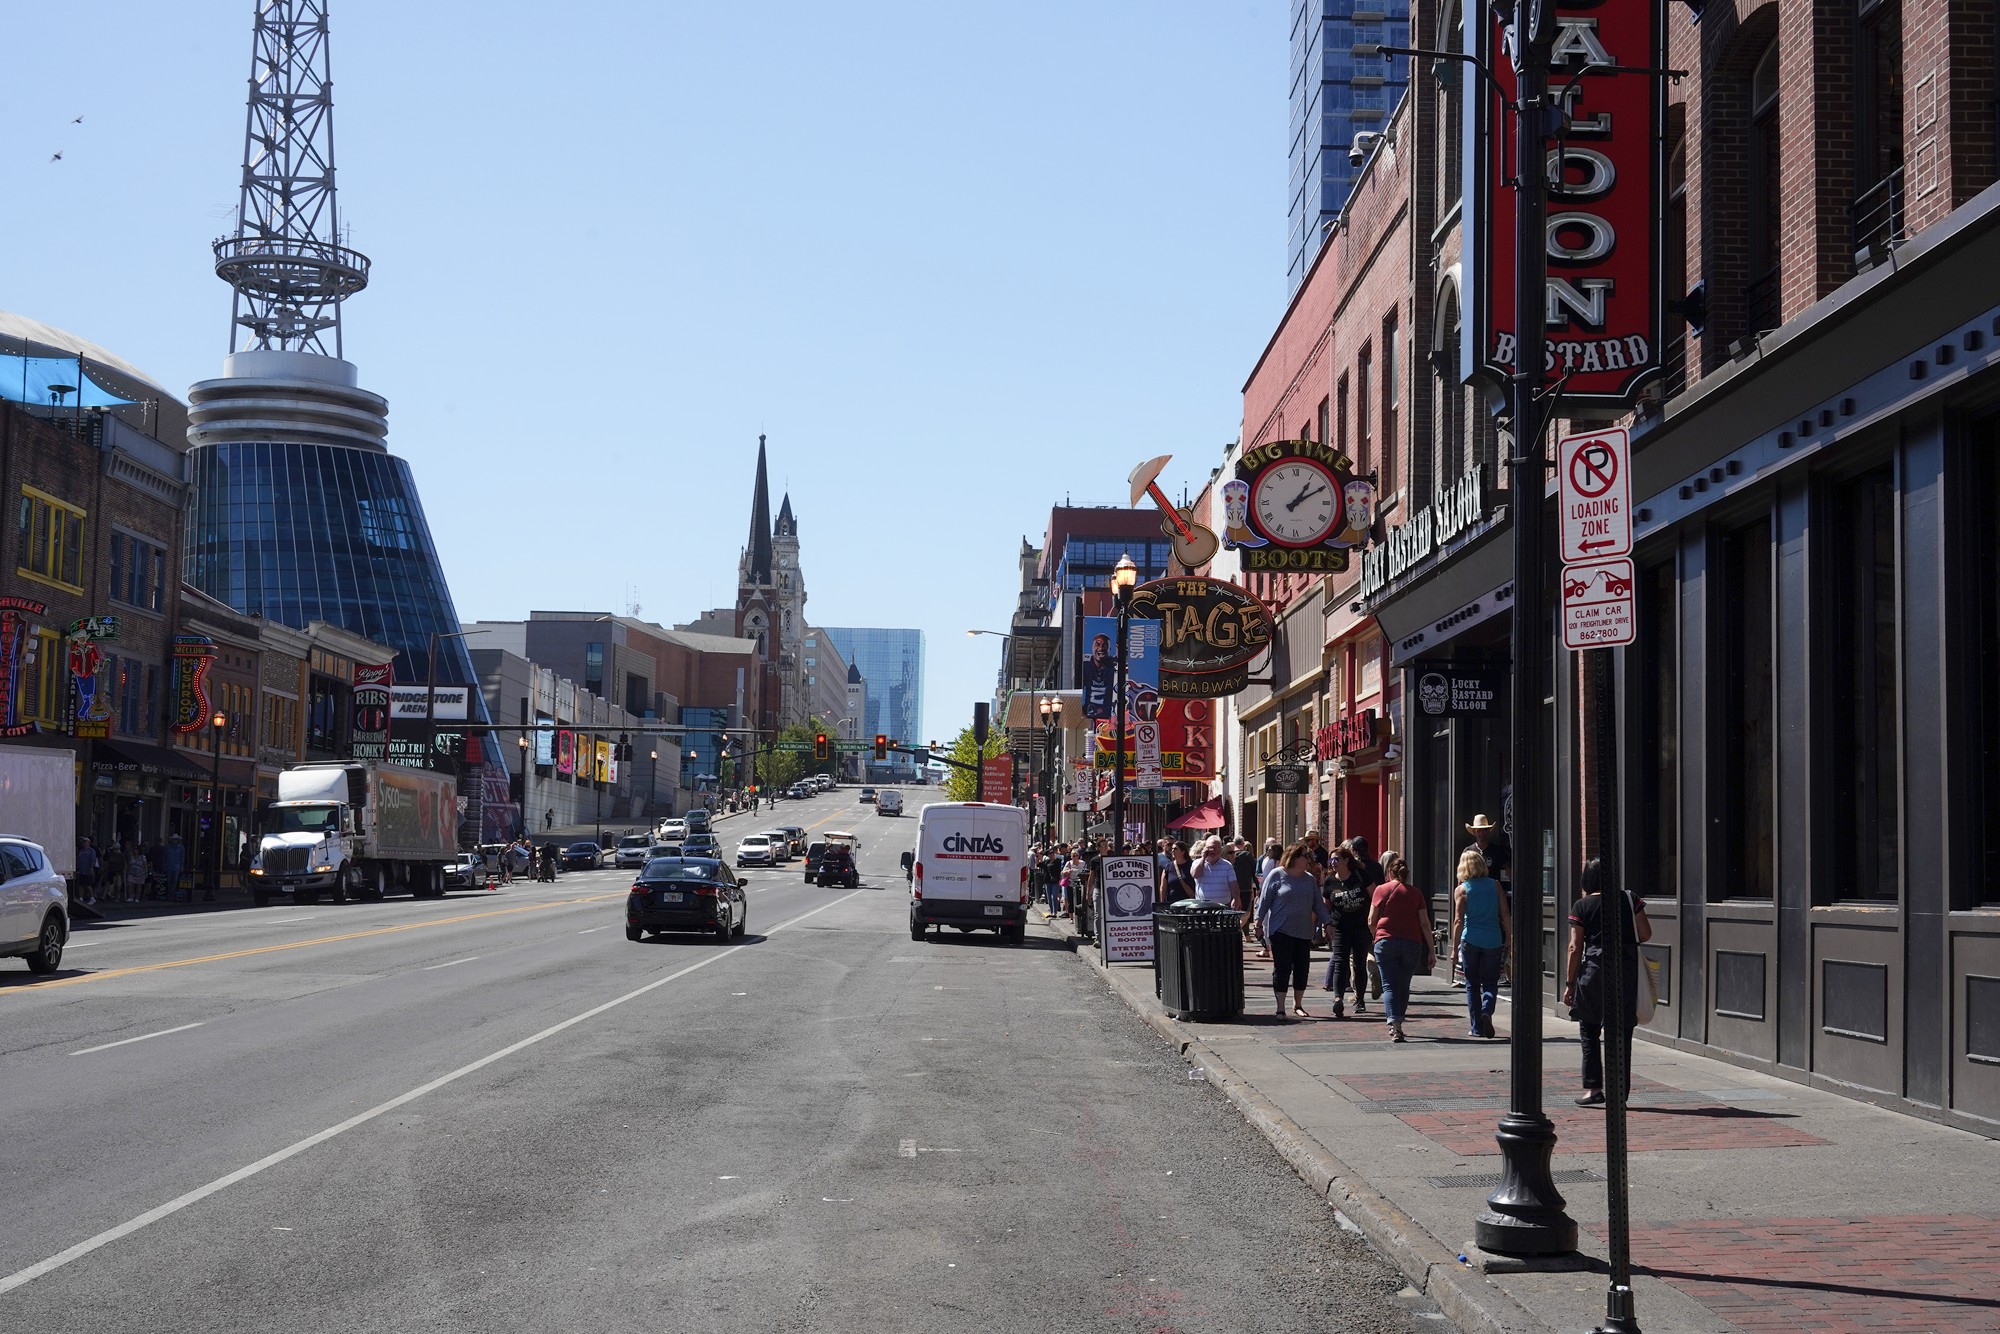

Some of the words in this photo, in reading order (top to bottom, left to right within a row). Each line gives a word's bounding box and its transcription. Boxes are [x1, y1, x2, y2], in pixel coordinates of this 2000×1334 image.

[1492, 332, 1650, 373] BSTARD
[1241, 443, 1282, 471] BIG
[1289, 440, 1351, 472] TIME
[1571, 497, 1619, 520] LOADING
[1360, 541, 1386, 600] LUCKY
[1388, 505, 1432, 581] BASTARD
[1435, 463, 1481, 546] SALOON
[1581, 518, 1610, 537] ZONE
[1250, 550, 1344, 569] BOOTS
[1176, 581, 1207, 596] THE
[1575, 608, 1600, 619] CLAIM
[1605, 606, 1622, 616] CAR
[1568, 622, 1578, 630] 1201
[1580, 618, 1612, 628] FREIGHTLINER
[1615, 616, 1629, 625] DRIVE
[1580, 628, 1619, 640] 862-7800
[1130, 625, 1145, 659] WOODS
[175, 646, 206, 654] MELLOW
[355, 665, 389, 680] Rippy's
[180, 658, 193, 722] MUSHROOM
[1162, 675, 1243, 693] BROADWAY
[1451, 678, 1480, 689] LUCKY
[355, 690, 387, 706] RIBS
[391, 692, 463, 703] RIDGETONE
[1451, 689, 1494, 700] BASTARD
[1451, 700, 1487, 710] SALOON
[78, 727, 106, 737] BAR
[1347, 710, 1371, 753] HATS
[353, 743, 386, 758] HONKY
[389, 744, 406, 753] OAD
[92, 762, 113, 770] Pizza
[118, 763, 138, 771] Beer
[1108, 862, 1124, 873] BIG
[1126, 861, 1149, 872] TIME
[1112, 870, 1145, 878] BOOTS
